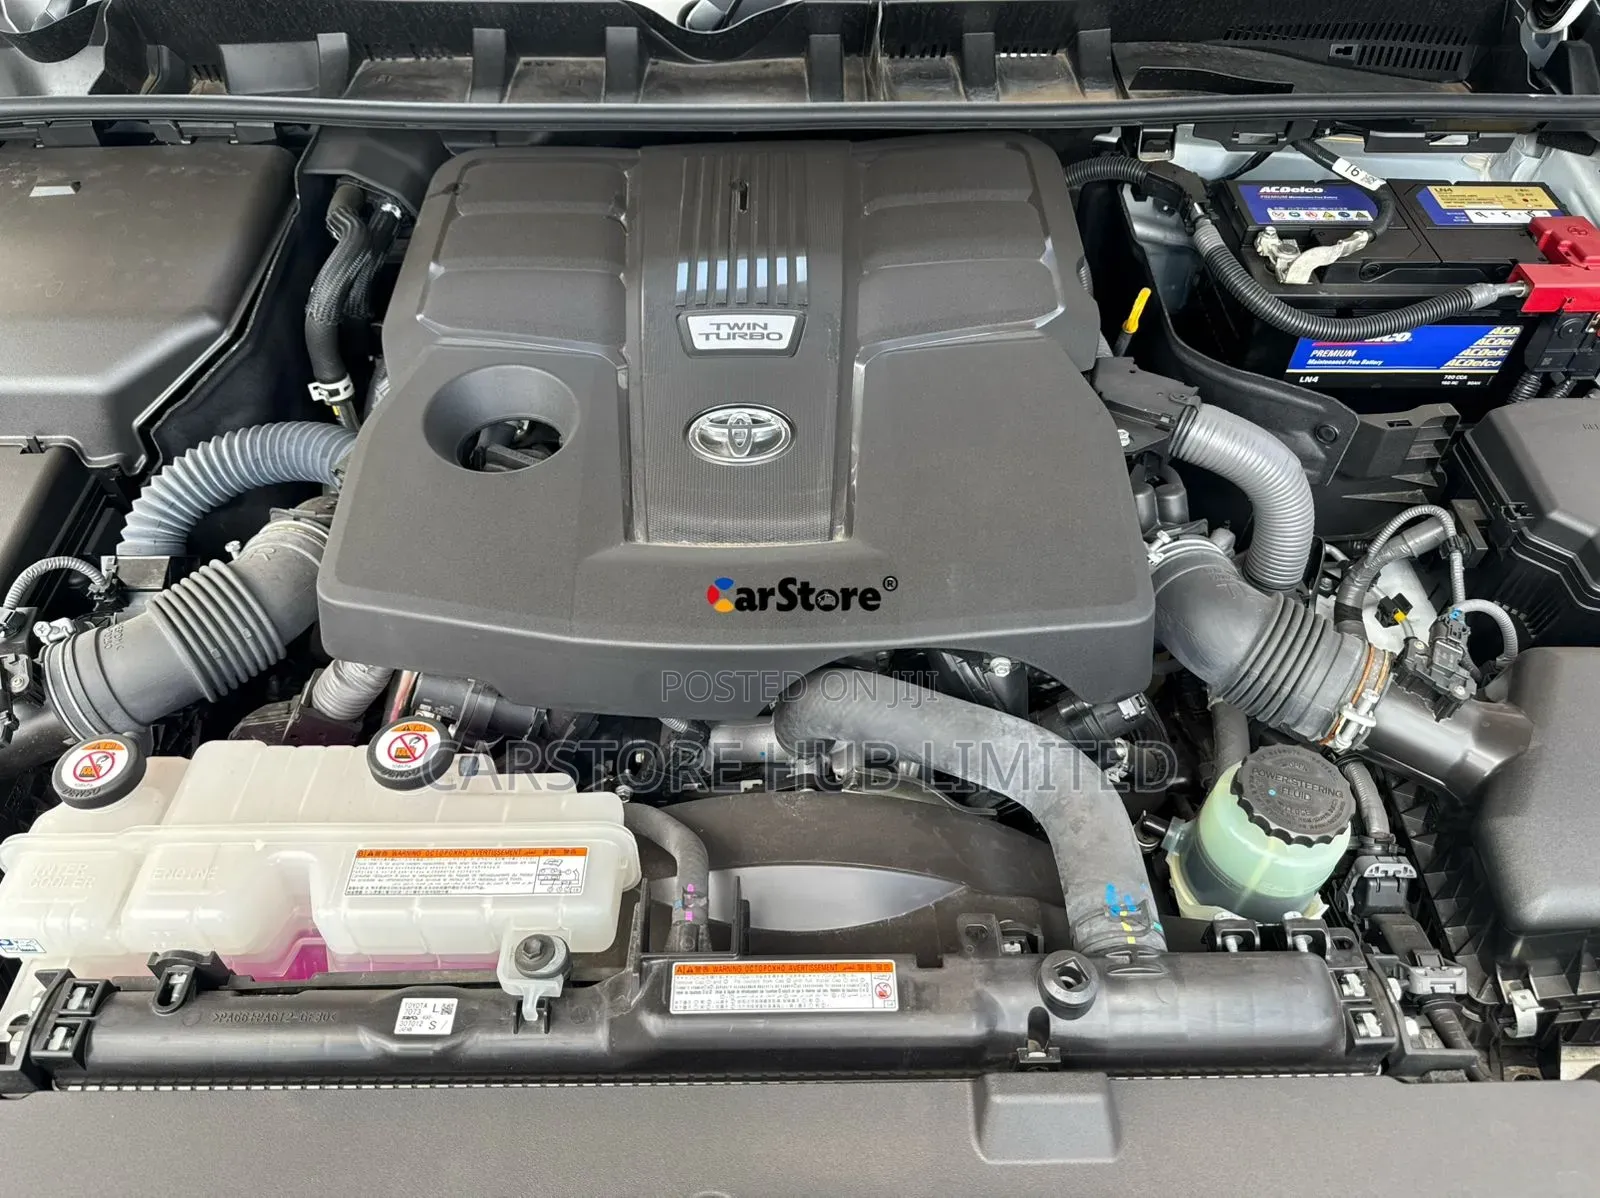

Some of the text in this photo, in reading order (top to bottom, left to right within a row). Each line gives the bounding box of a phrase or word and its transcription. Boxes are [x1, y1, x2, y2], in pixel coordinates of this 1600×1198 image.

[709, 322, 769, 331] TWIN
[698, 332, 784, 341] TURBO
[1310, 349, 1358, 358] PREMIUM
[1360, 359, 1384, 367] Battery
[1443, 358, 1502, 367] ACDelco
[62, 786, 101, 798] DENSO
[1281, 786, 1312, 801] FLUID
[33, 864, 89, 877] INTER
[151, 866, 219, 881] ENGINE
[29, 876, 96, 888] COOLER
[713, 964, 742, 973] WARNING
[788, 963, 838, 972] AVERTISSEMENT
[432, 1003, 440, 1013] L
[429, 1021, 438, 1031] S
